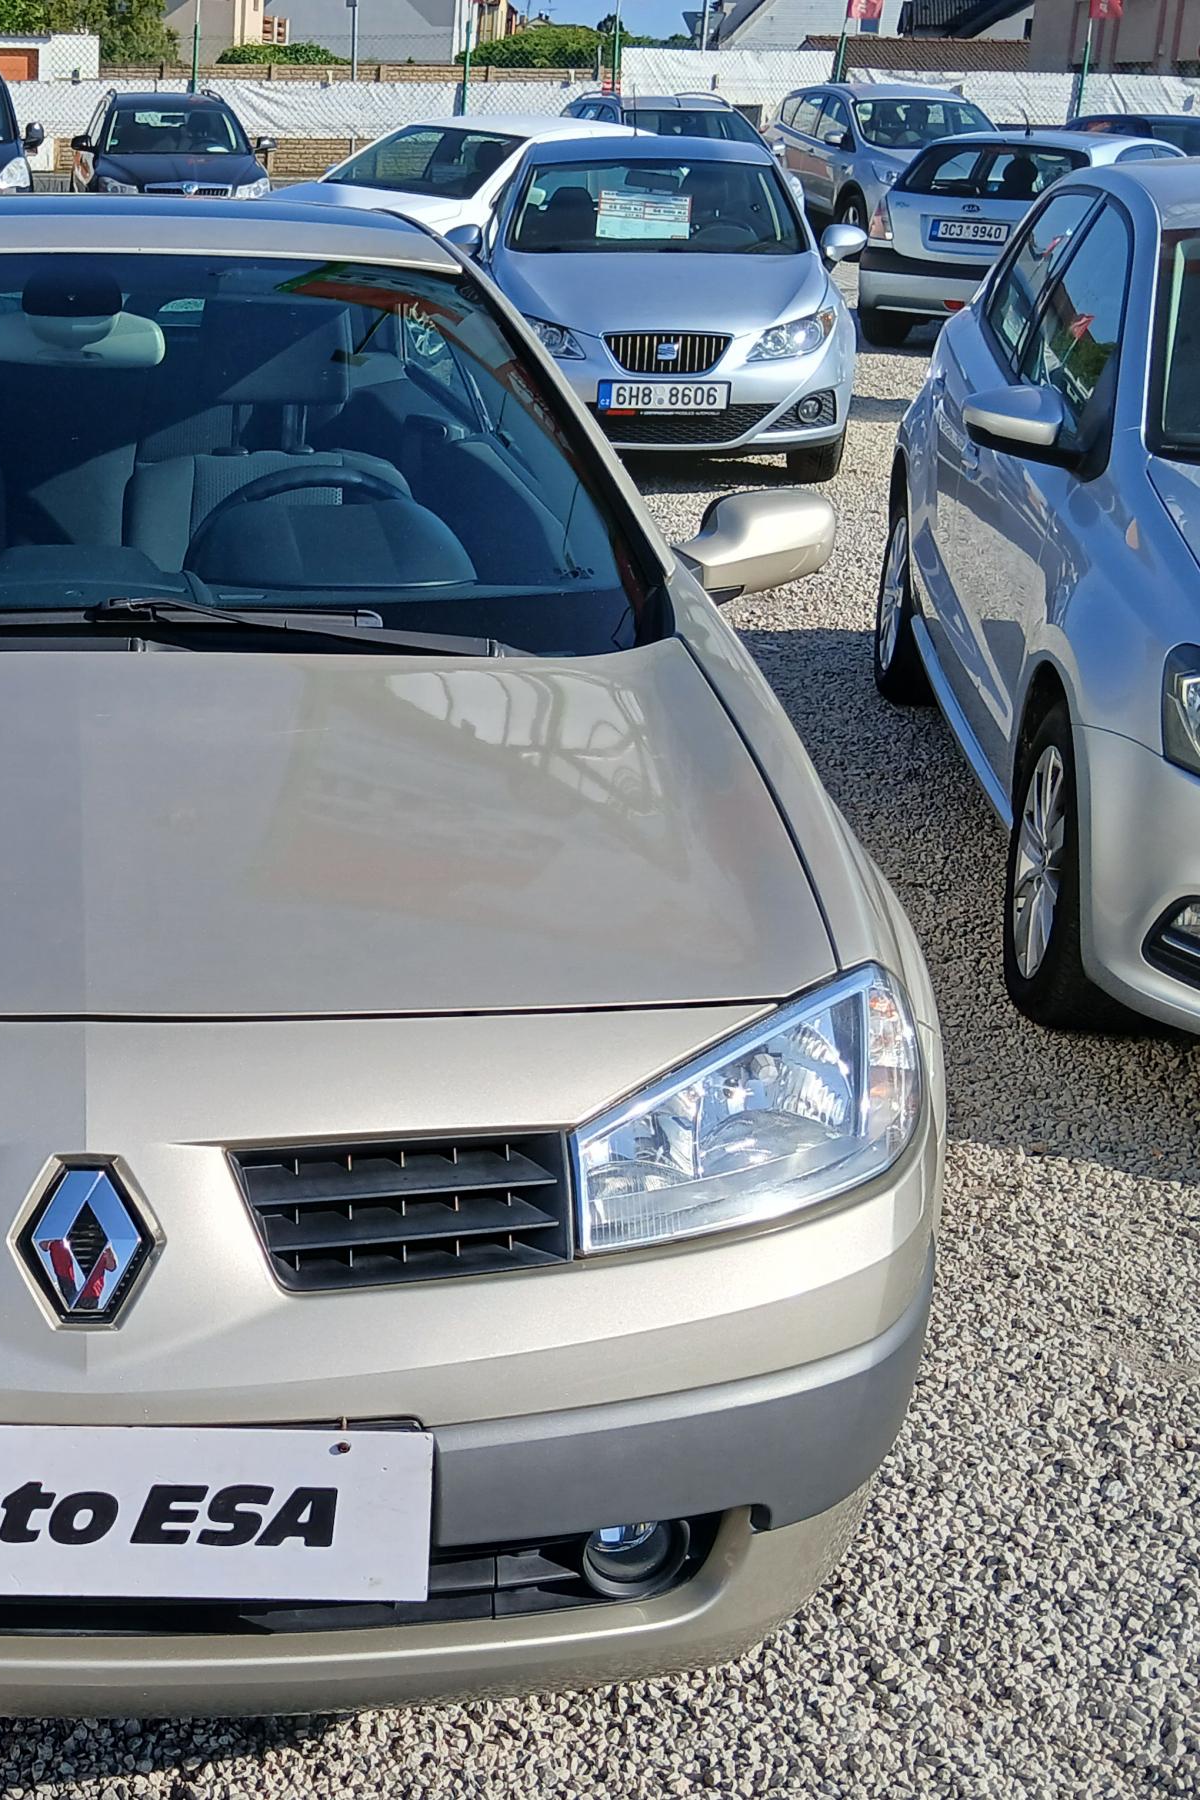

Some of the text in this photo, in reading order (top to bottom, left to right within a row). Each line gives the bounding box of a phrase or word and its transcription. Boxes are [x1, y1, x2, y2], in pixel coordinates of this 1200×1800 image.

[940, 223, 964, 237] 3C3
[971, 225, 1002, 240] 9940
[615, 386, 718, 407] 6H8 8606
[128, 1484, 339, 1549] ESA
